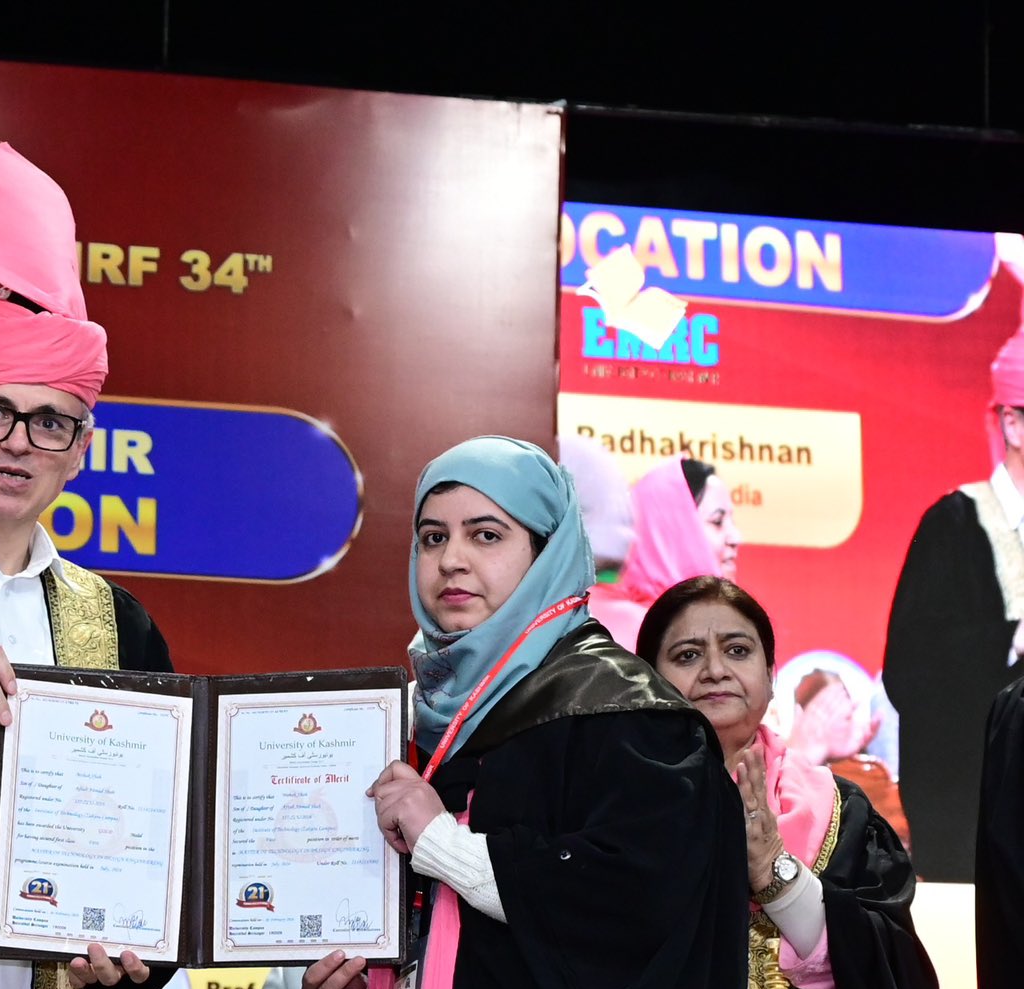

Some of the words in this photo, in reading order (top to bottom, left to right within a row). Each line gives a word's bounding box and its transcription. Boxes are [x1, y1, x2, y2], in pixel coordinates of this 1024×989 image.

[179, 249, 273, 294] 34TH
[730, 483, 764, 507] dia
[48, 731, 95, 746] University
[98, 736, 107, 746] of
[109, 738, 147, 750] Kashmir
[439, 711, 463, 749] UNIVERSITY
[259, 741, 304, 752] University
[306, 740, 316, 749] of
[318, 739, 356, 748] Kashmir
[270, 775, 312, 785] Certificate
[314, 774, 323, 784] of
[325, 773, 350, 784] Merit
